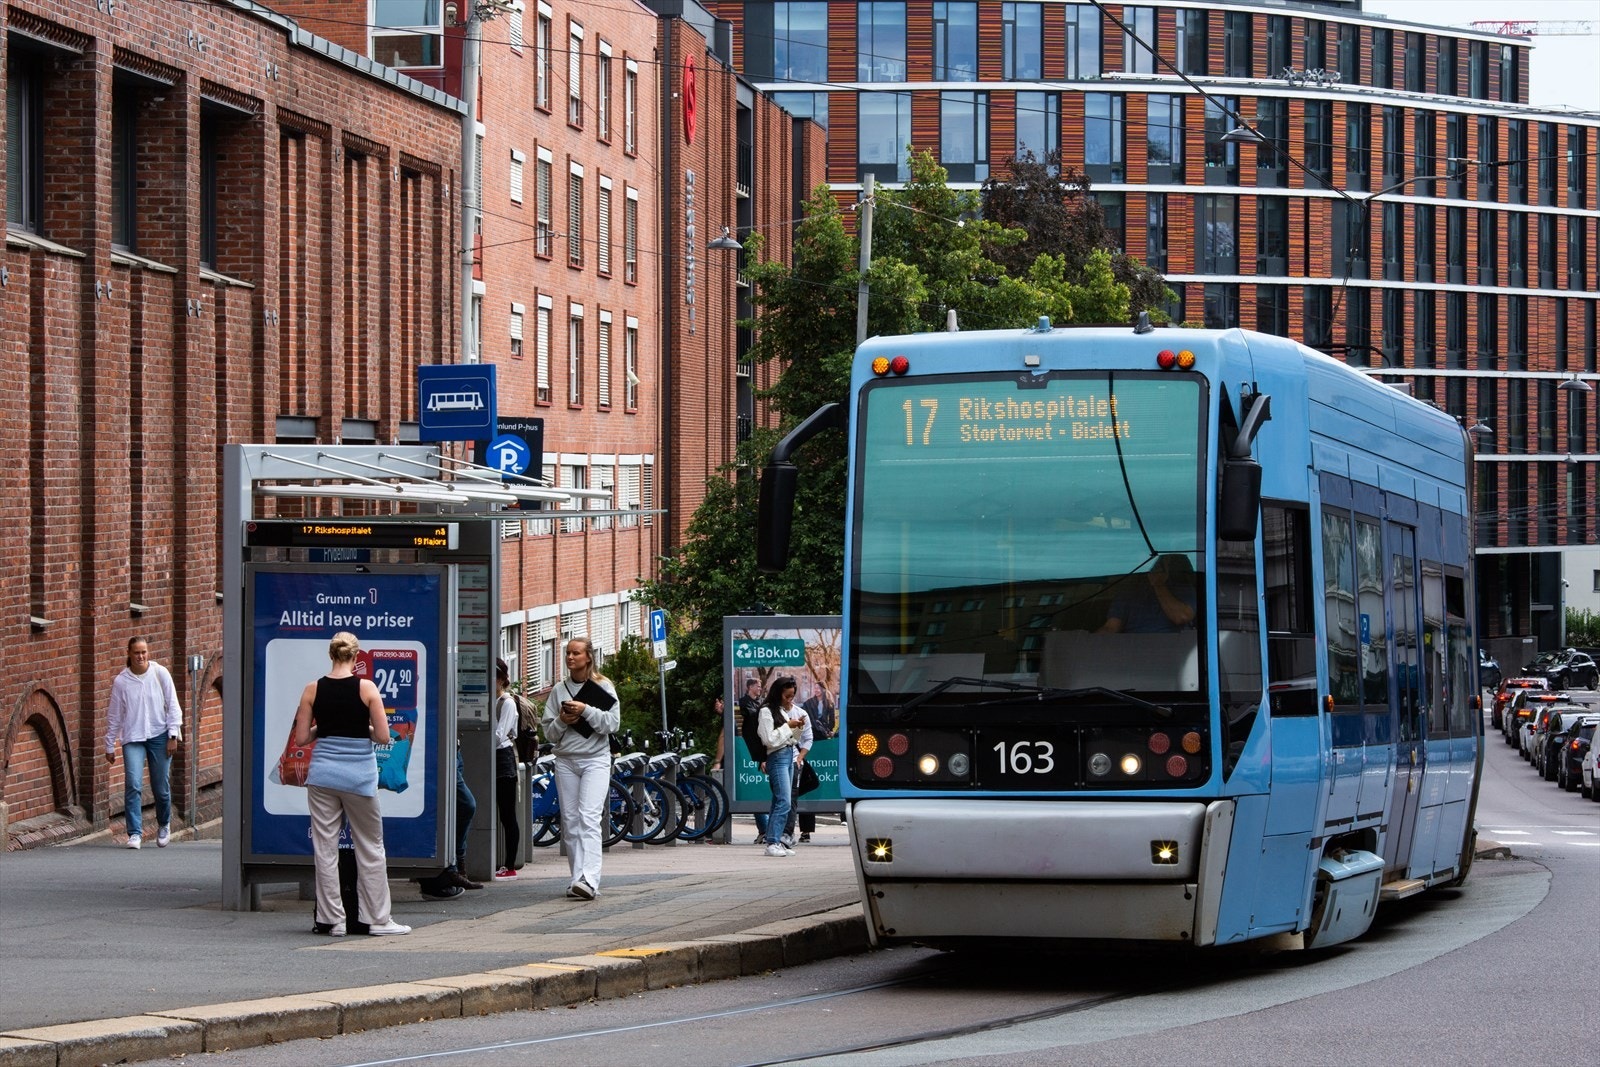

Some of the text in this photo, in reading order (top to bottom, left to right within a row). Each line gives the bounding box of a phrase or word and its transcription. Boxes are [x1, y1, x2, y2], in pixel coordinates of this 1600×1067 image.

[959, 395, 1118, 420] Rikshospitalet
[518, 423, 538, 431] P-hus
[902, 399, 938, 445] 17
[960, 422, 1053, 442] Stortorvet
[1071, 420, 1130, 439] Bislett
[500, 448, 518, 470] P
[302, 526, 446, 536] 17 Rikshospitalet nå
[413, 537, 422, 545] 19
[316, 588, 377, 605] Grunn nr 1
[279, 610, 414, 630] Alltid lave priser
[654, 614, 662, 639] P
[753, 646, 800, 659] iBok.no
[375, 668, 412, 699] 24 90
[993, 741, 1055, 774] 163
[739, 773, 762, 785] Kjøp
